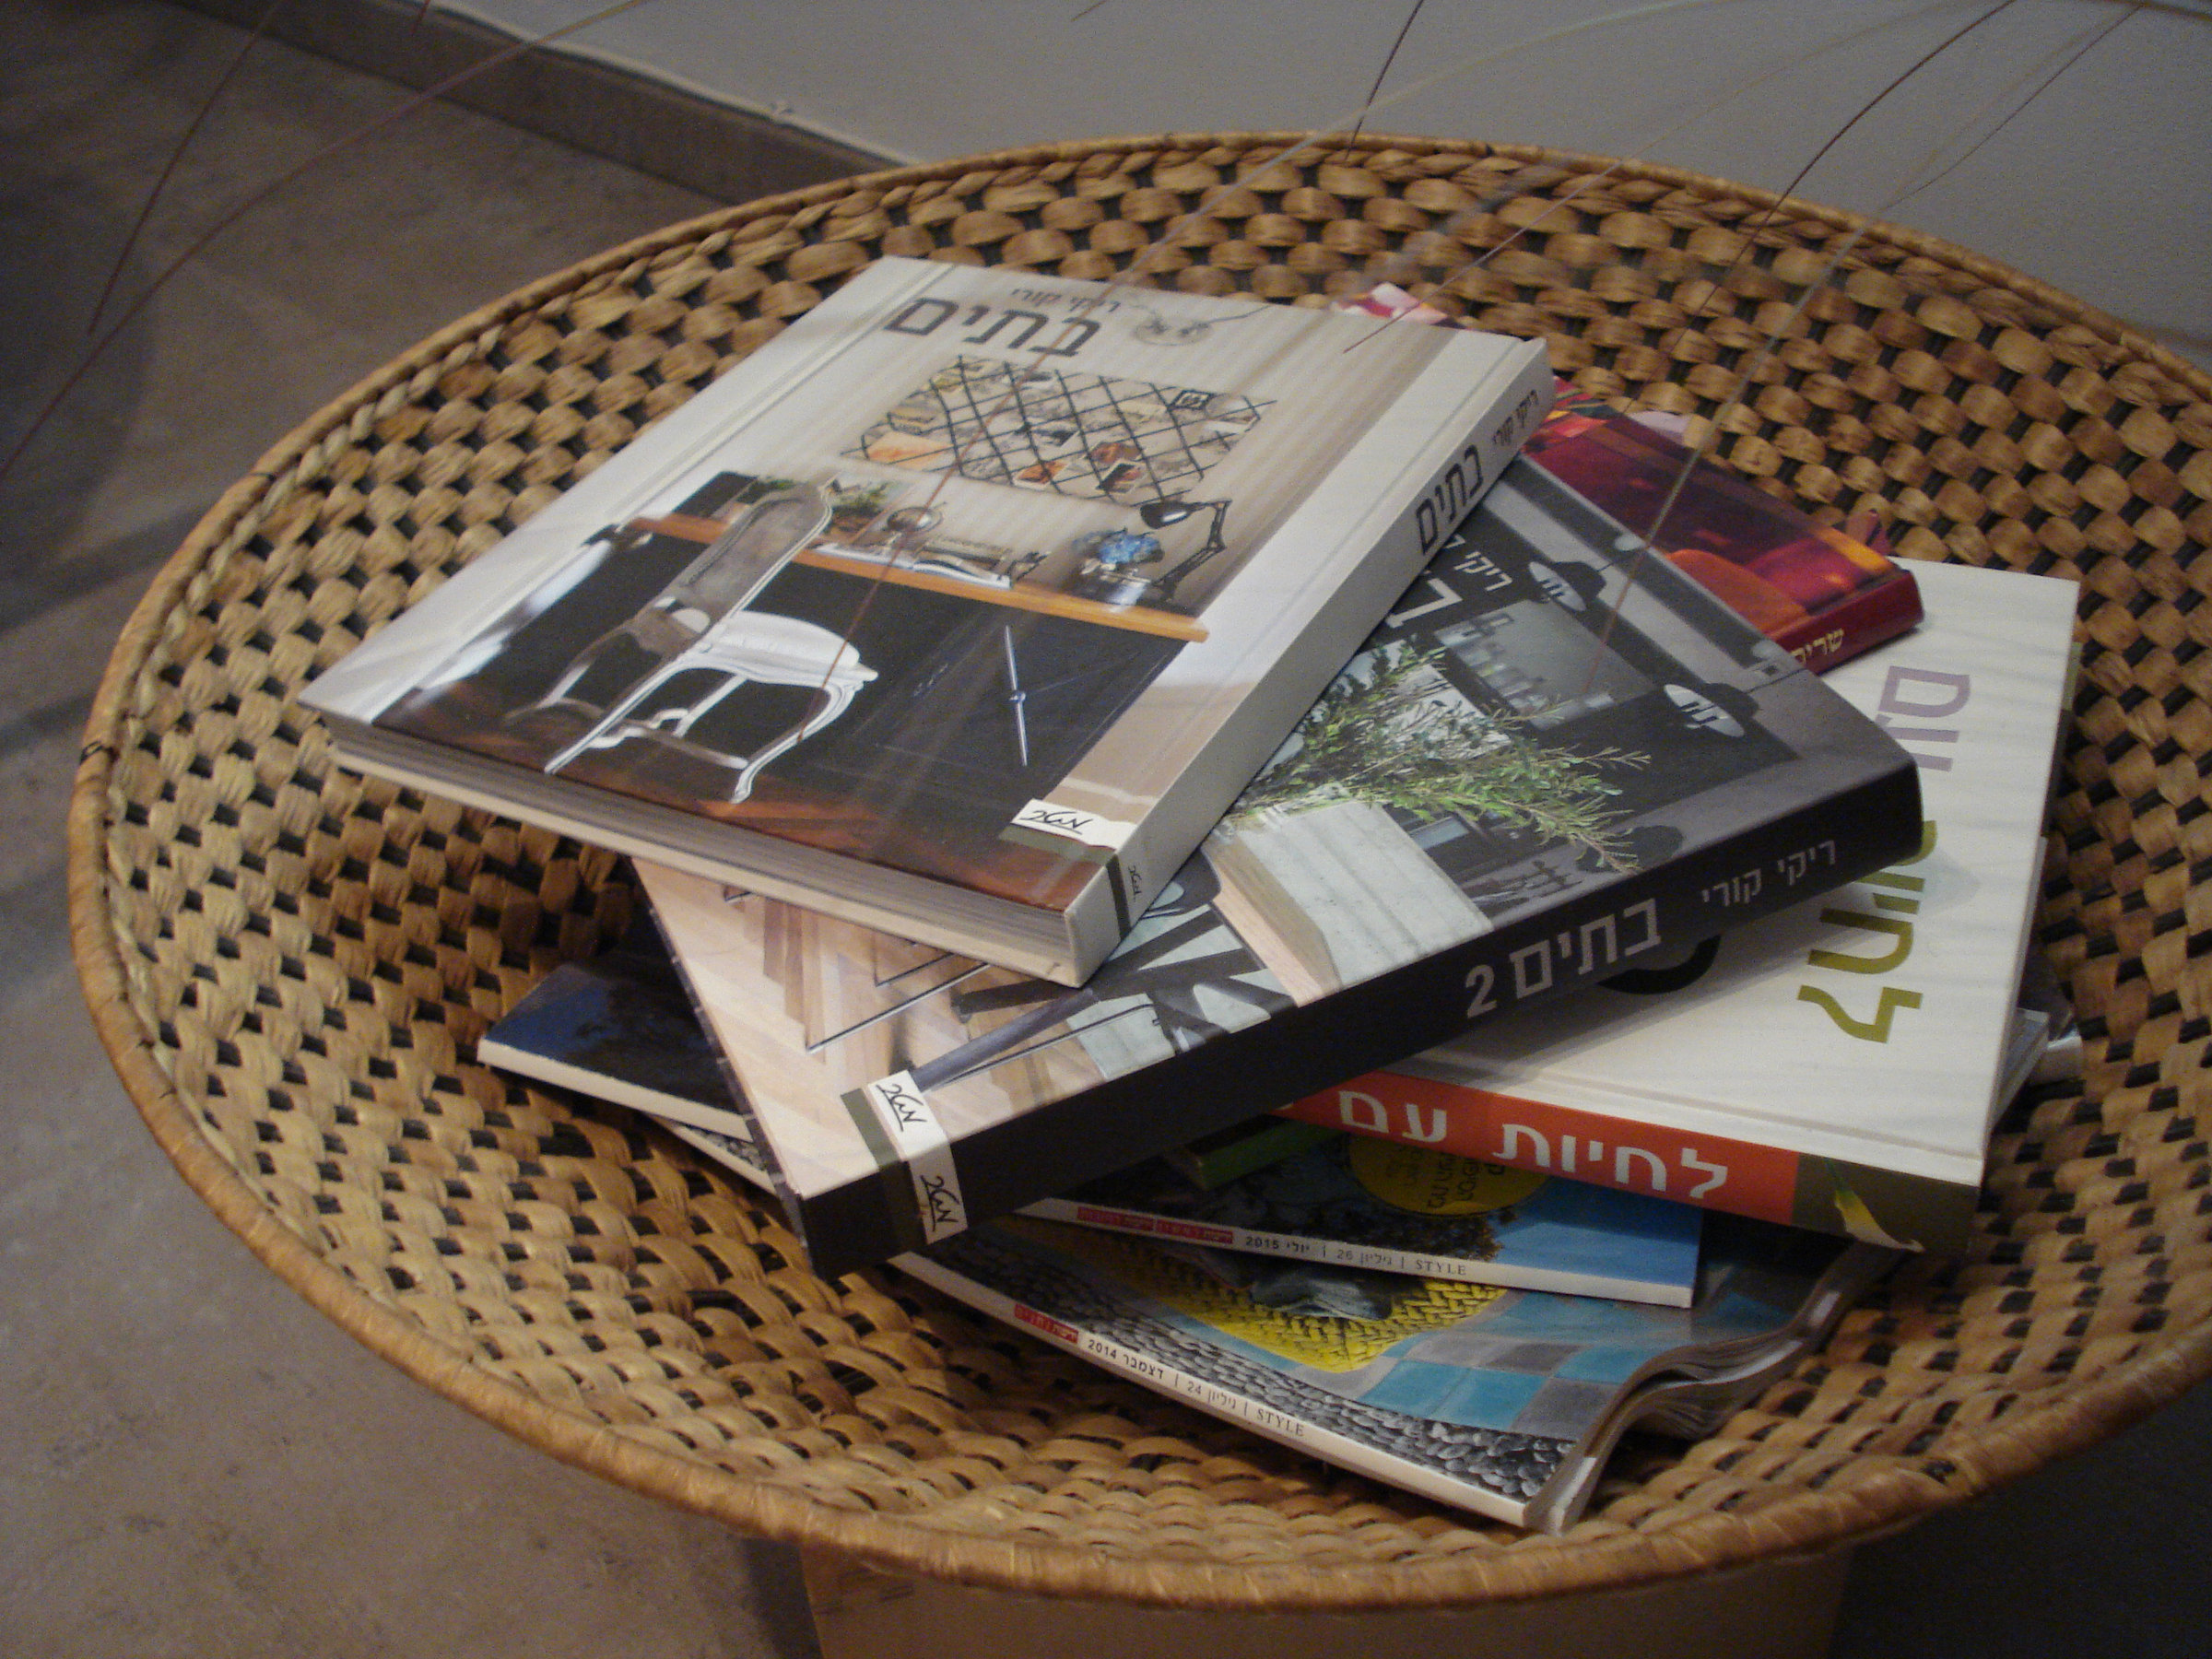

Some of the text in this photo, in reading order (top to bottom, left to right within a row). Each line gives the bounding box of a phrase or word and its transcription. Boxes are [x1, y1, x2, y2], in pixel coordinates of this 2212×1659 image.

[884, 297, 1101, 357] בתים
[1416, 444, 1483, 556] בתים
[1453, 551, 1512, 591] ריקי
[1701, 840, 1836, 908] ריקי קורי
[1465, 898, 1662, 1019] בתים 2
[1337, 1089, 1447, 1144] עם
[1492, 1123, 1728, 1199] לחיות
[1245, 1235, 1279, 1250] 2015
[1415, 1259, 1466, 1276] STYLE
[1088, 1338, 1117, 1360] 2014
[1124, 1354, 1164, 1381] דצמבר
[1187, 1380, 1202, 1395] 24
[1256, 1407, 1305, 1438] STYLE
